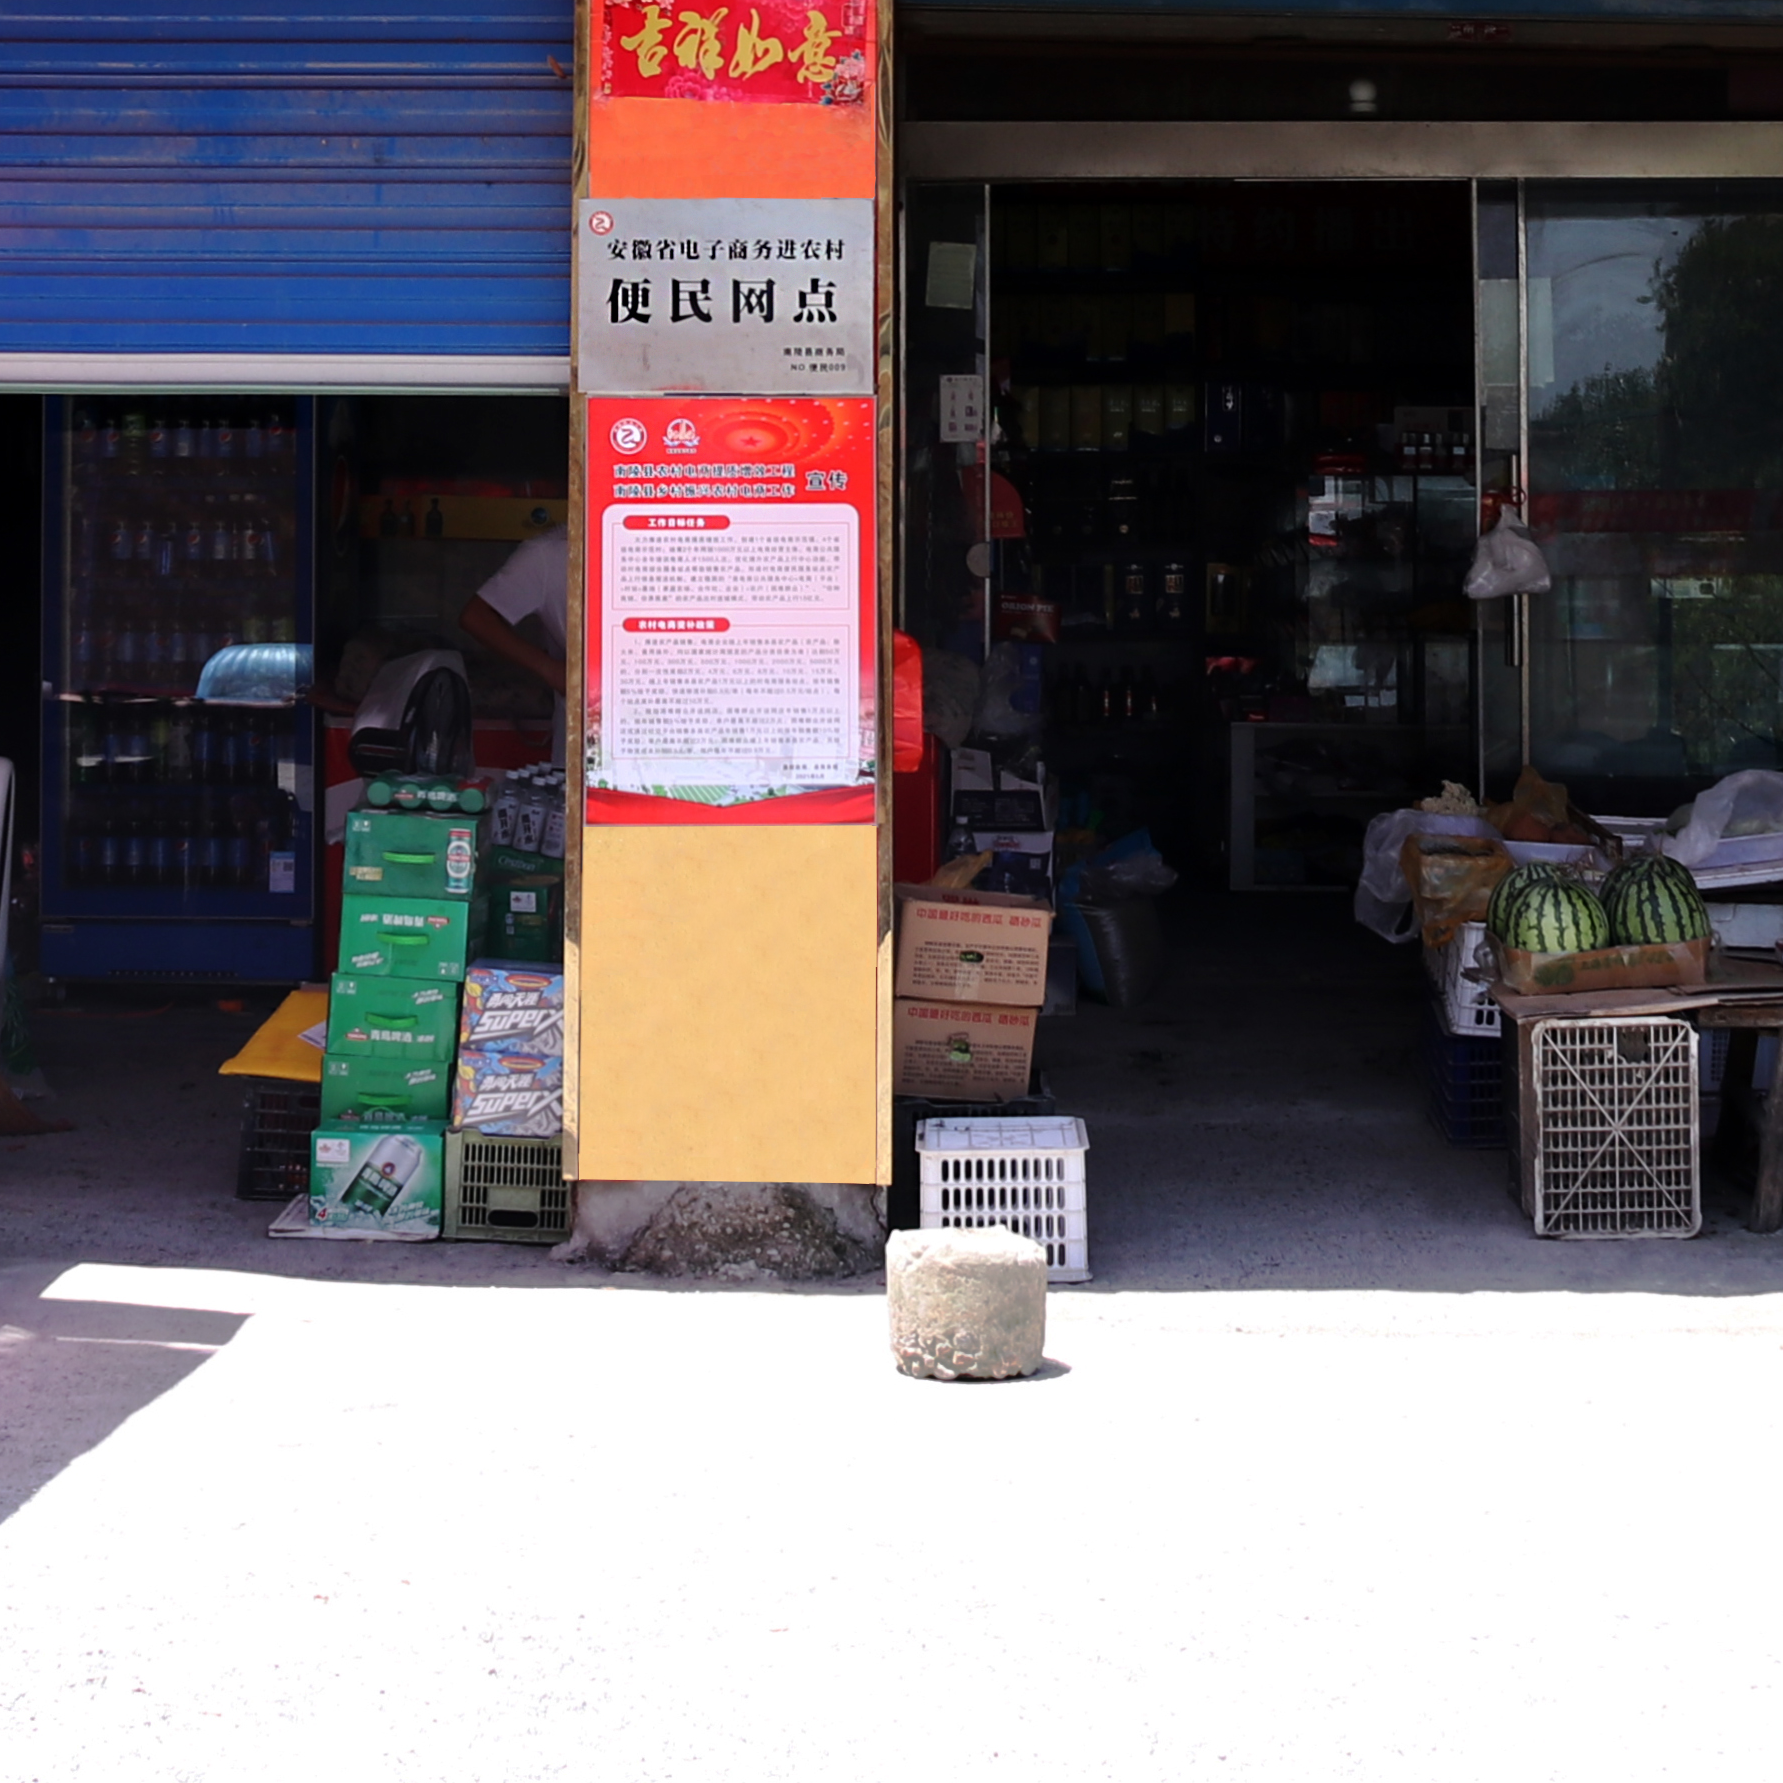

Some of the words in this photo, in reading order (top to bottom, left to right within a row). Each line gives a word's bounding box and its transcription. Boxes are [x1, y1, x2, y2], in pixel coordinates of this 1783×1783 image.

[620, 5, 843, 84] 吉祥如意
[607, 238, 845, 261] 安徽省电子商务进农村
[606, 277, 839, 325] 便民网点
[805, 470, 848, 492] 宣传
